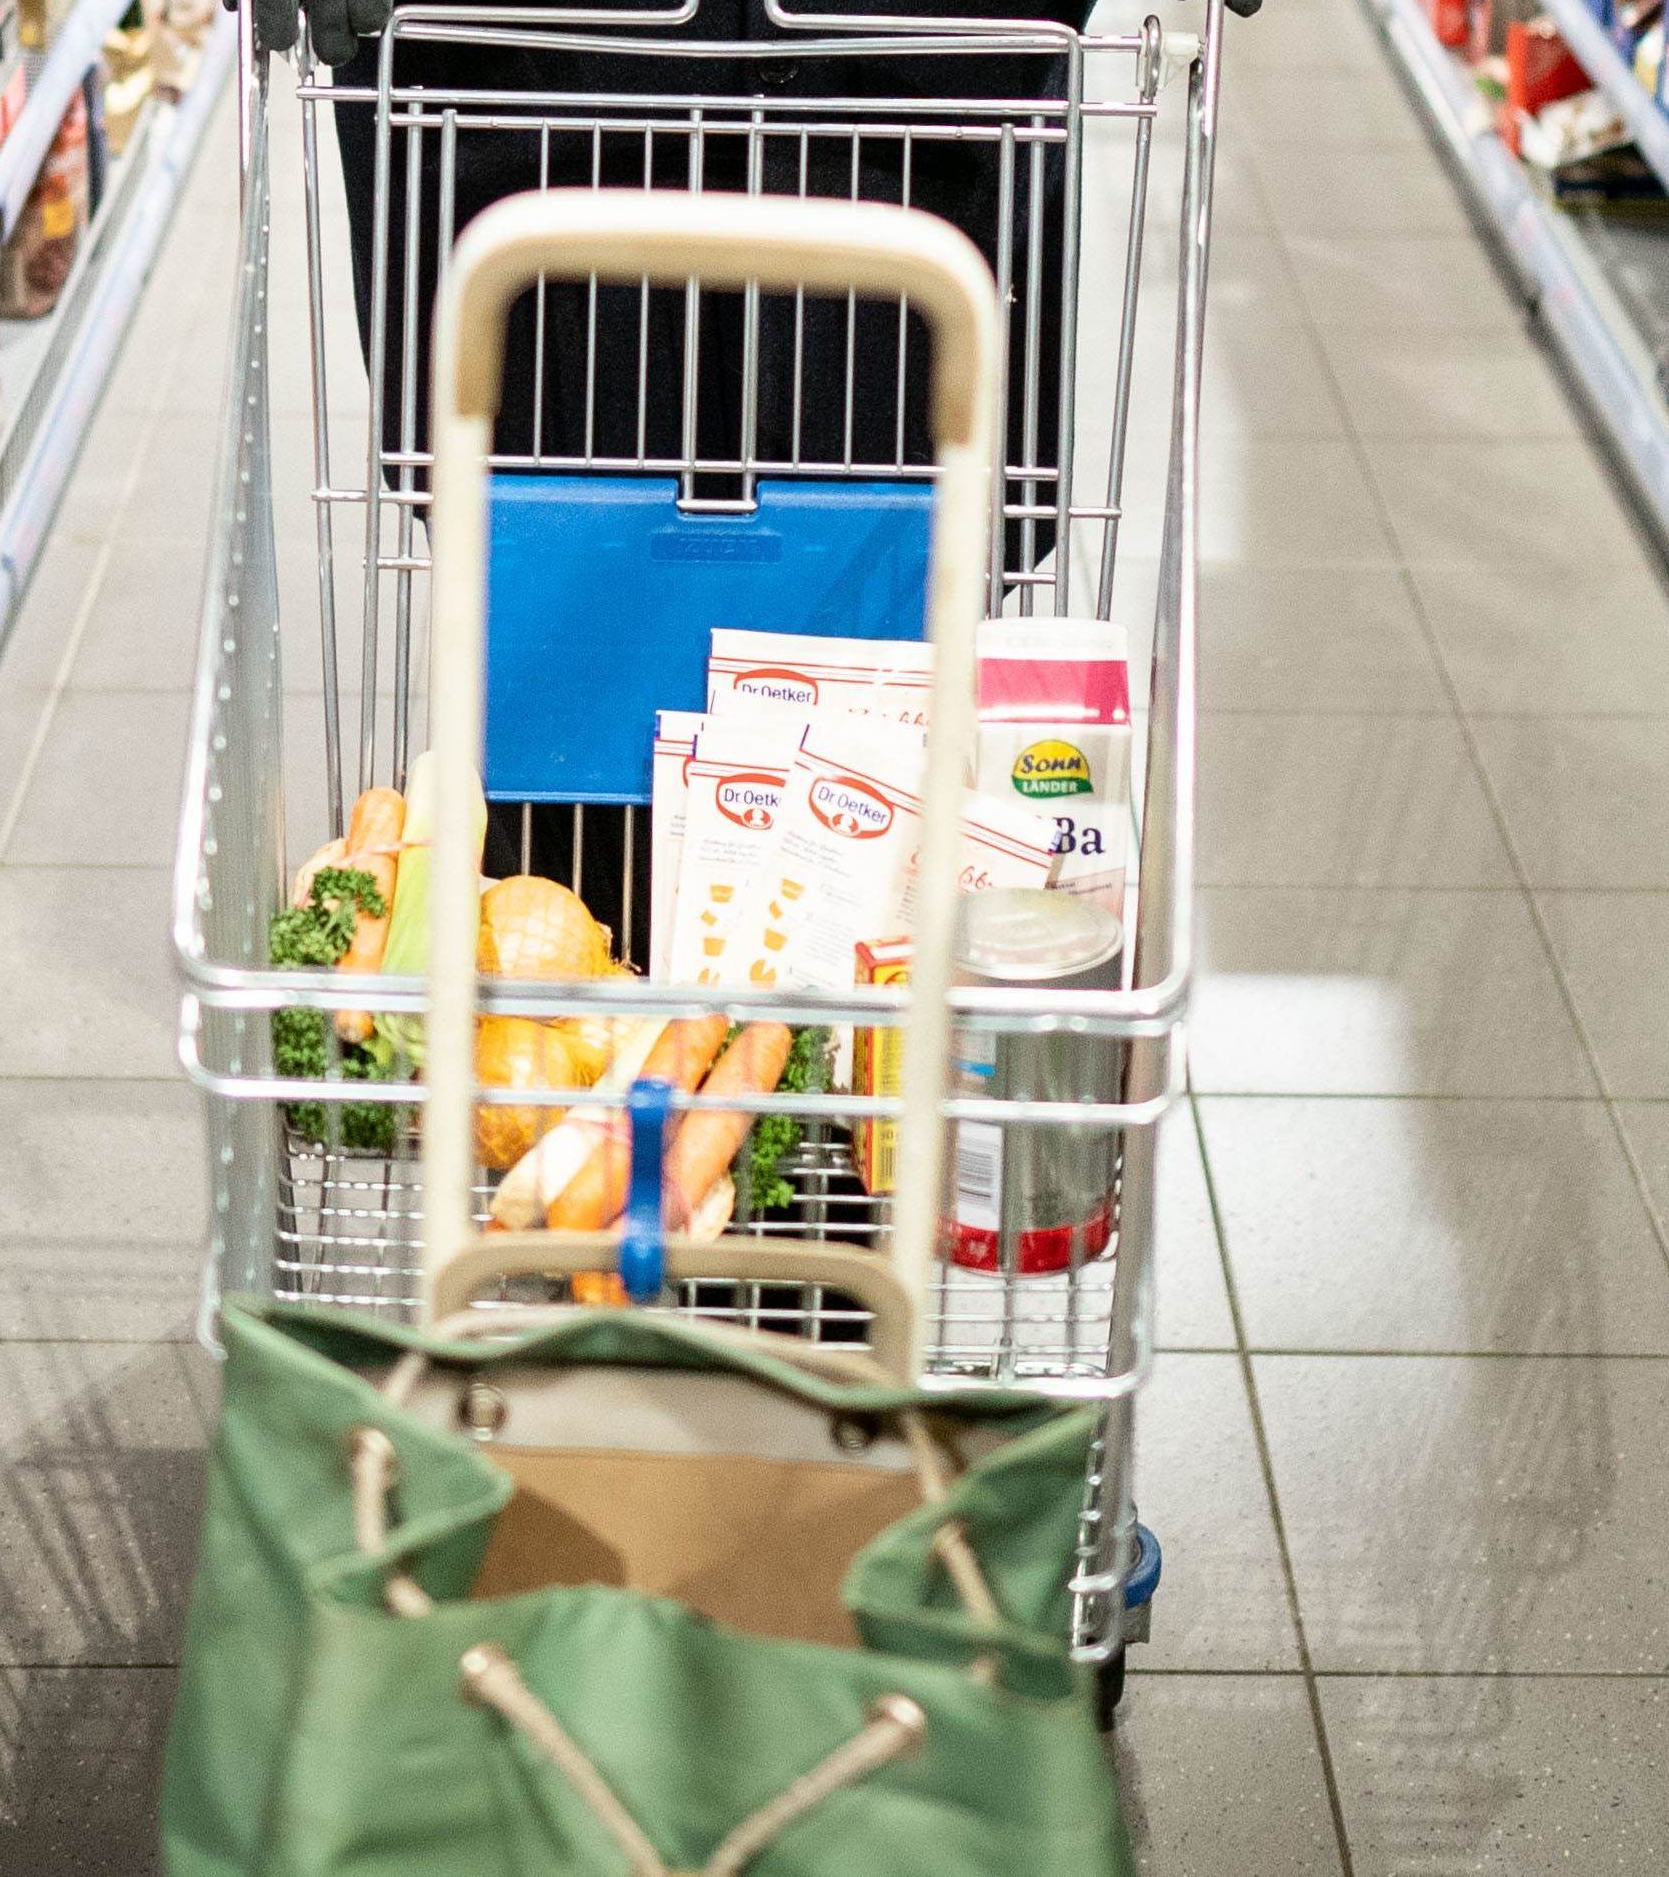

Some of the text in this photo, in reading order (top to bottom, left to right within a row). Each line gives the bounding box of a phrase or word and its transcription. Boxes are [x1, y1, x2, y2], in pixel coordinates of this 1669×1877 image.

[1021, 753, 1082, 775] Sonn
[743, 789, 779, 807] Oetk
[837, 792, 888, 826] Oetker
